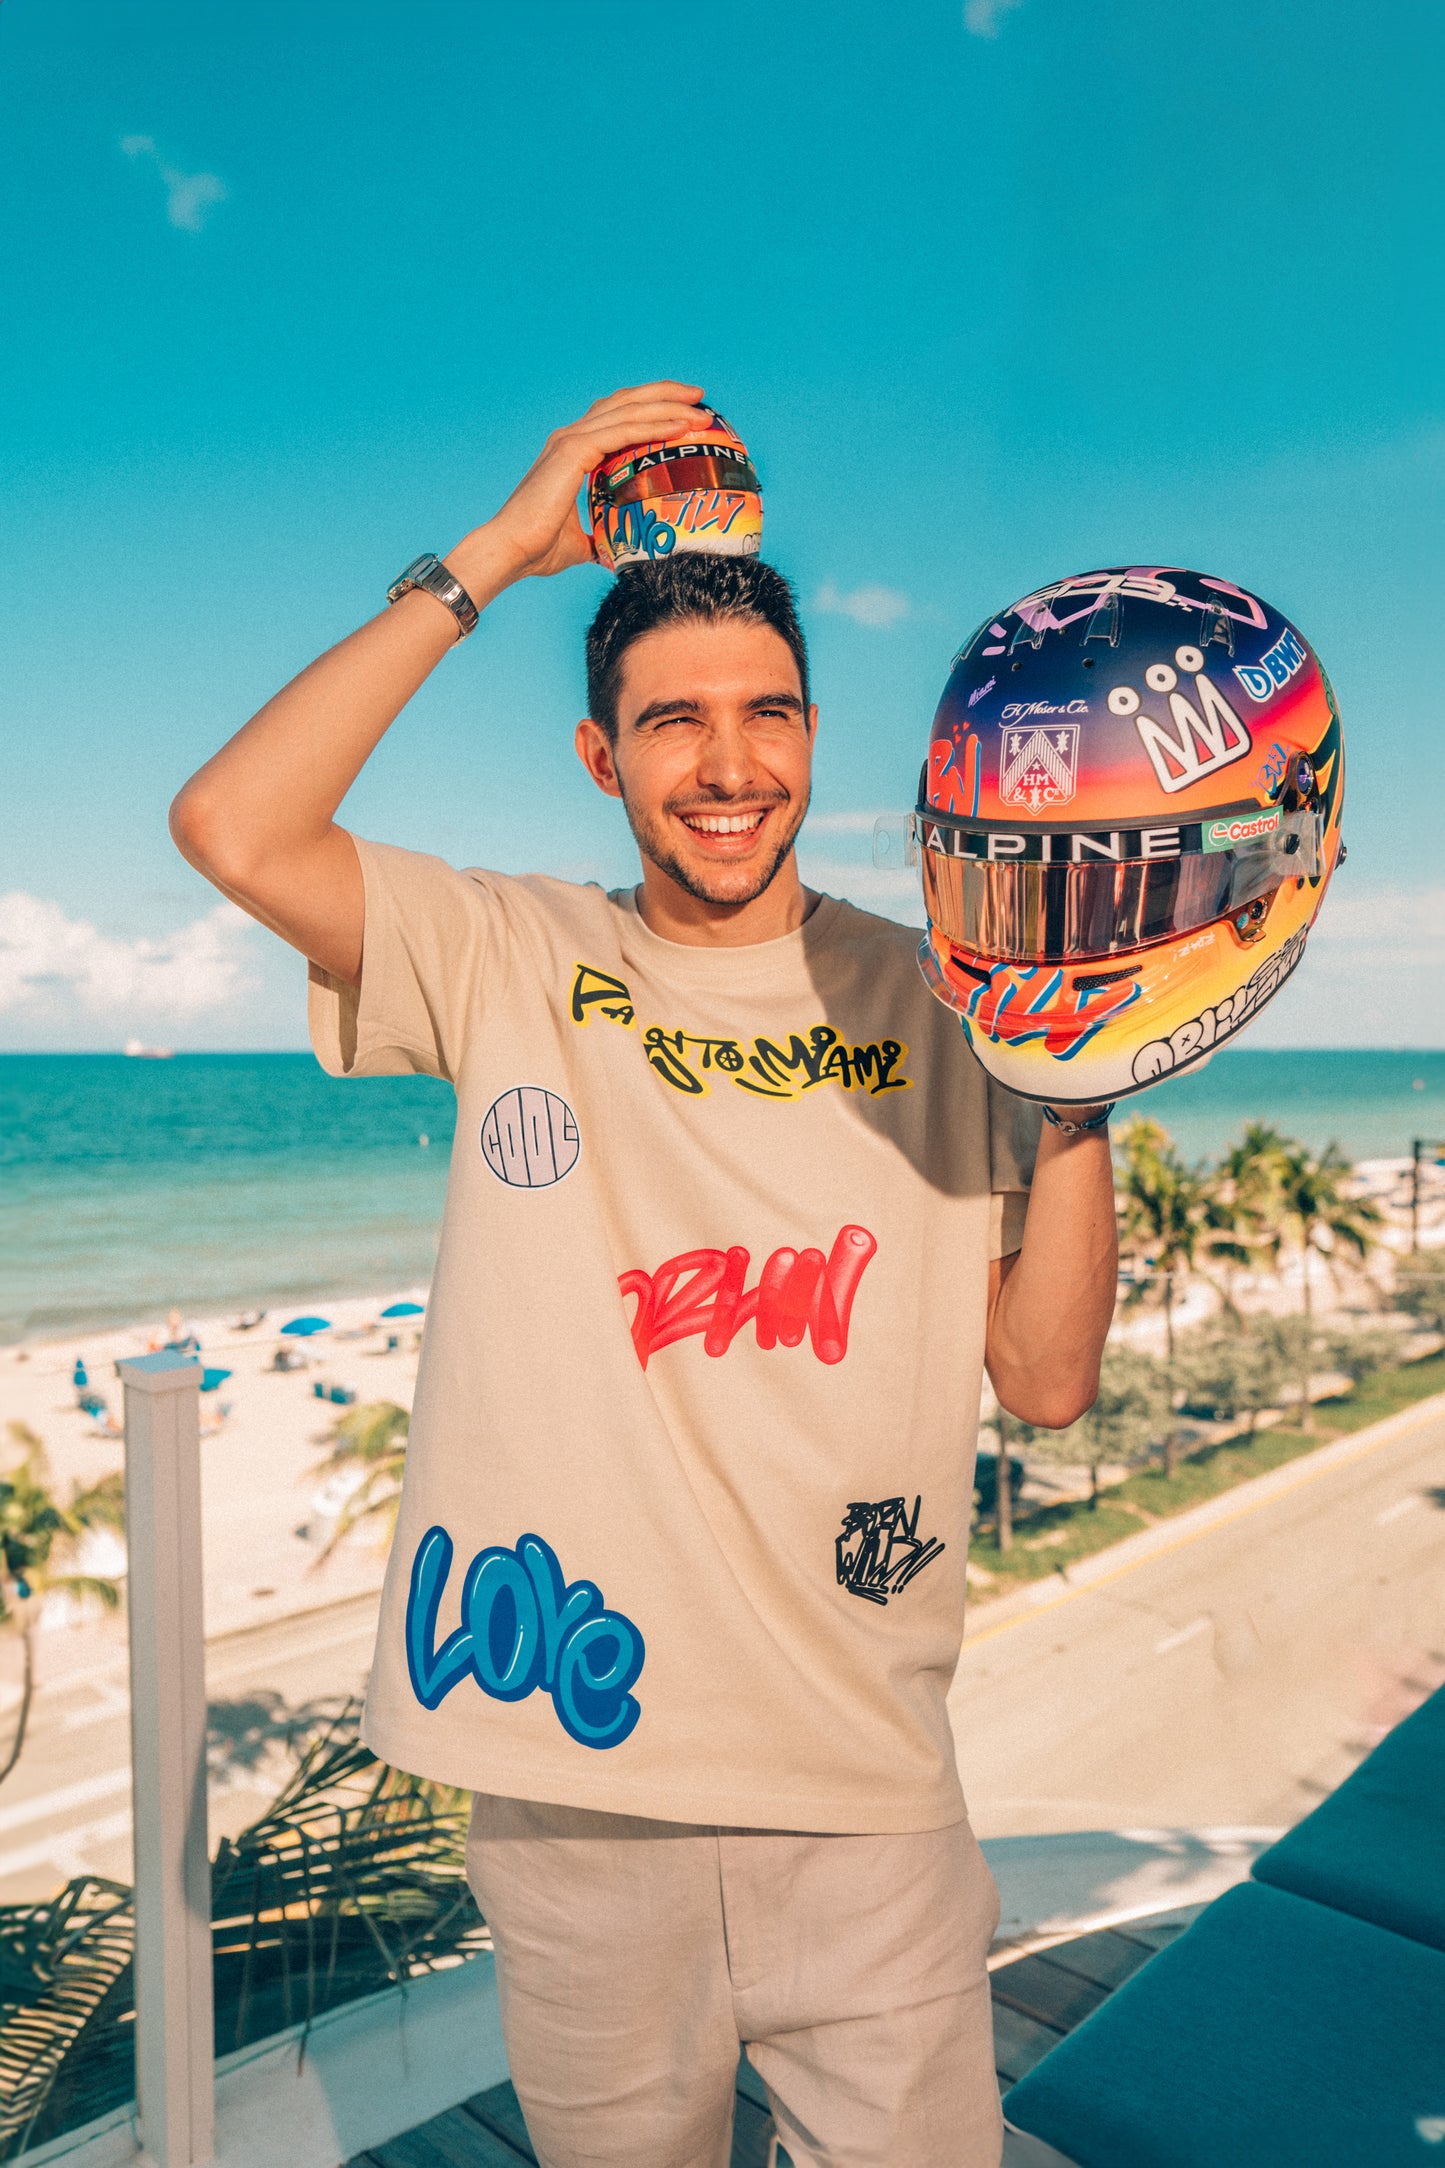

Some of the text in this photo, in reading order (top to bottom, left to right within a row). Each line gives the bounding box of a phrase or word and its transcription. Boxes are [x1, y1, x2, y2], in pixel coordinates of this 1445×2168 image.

[637, 444, 747, 472] ALPINE
[1259, 627, 1307, 690] BWT
[1013, 787, 1027, 801] &
[1022, 773, 1050, 786] HM
[1228, 811, 1280, 841] Castrol
[925, 826, 1182, 864] ALPINE
